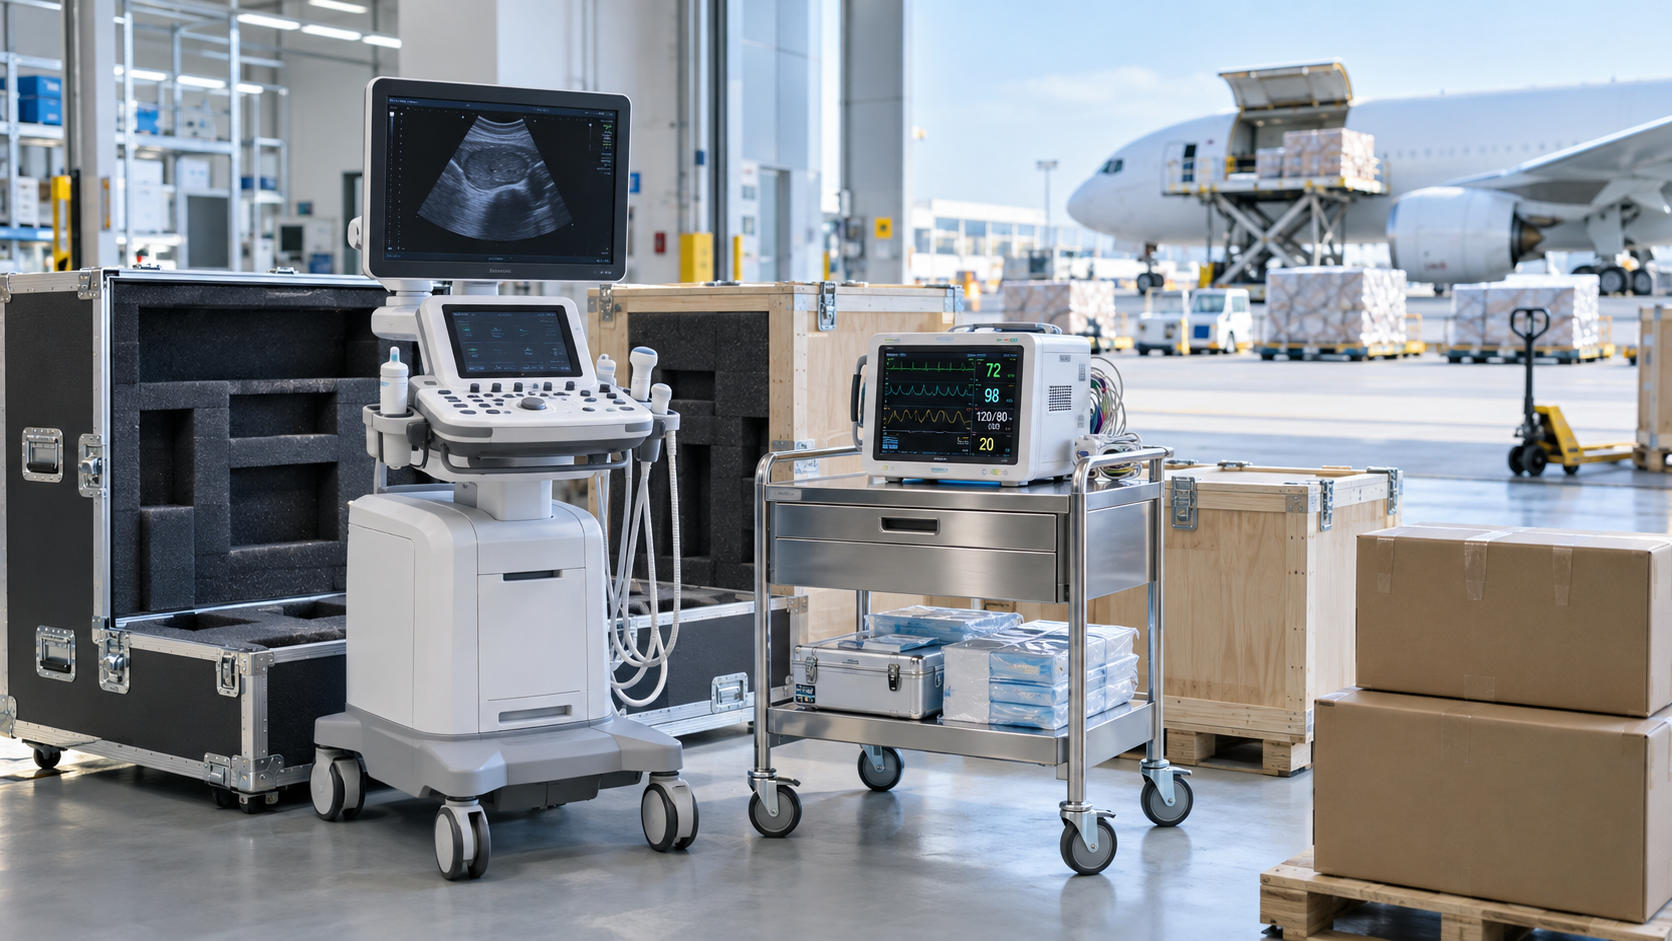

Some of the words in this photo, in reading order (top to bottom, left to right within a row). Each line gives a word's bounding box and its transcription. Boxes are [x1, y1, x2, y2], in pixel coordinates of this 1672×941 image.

[986, 362, 1001, 378] 72
[984, 388, 999, 403] 98
[976, 411, 1008, 422] 120/80
[979, 437, 994, 451] 20
